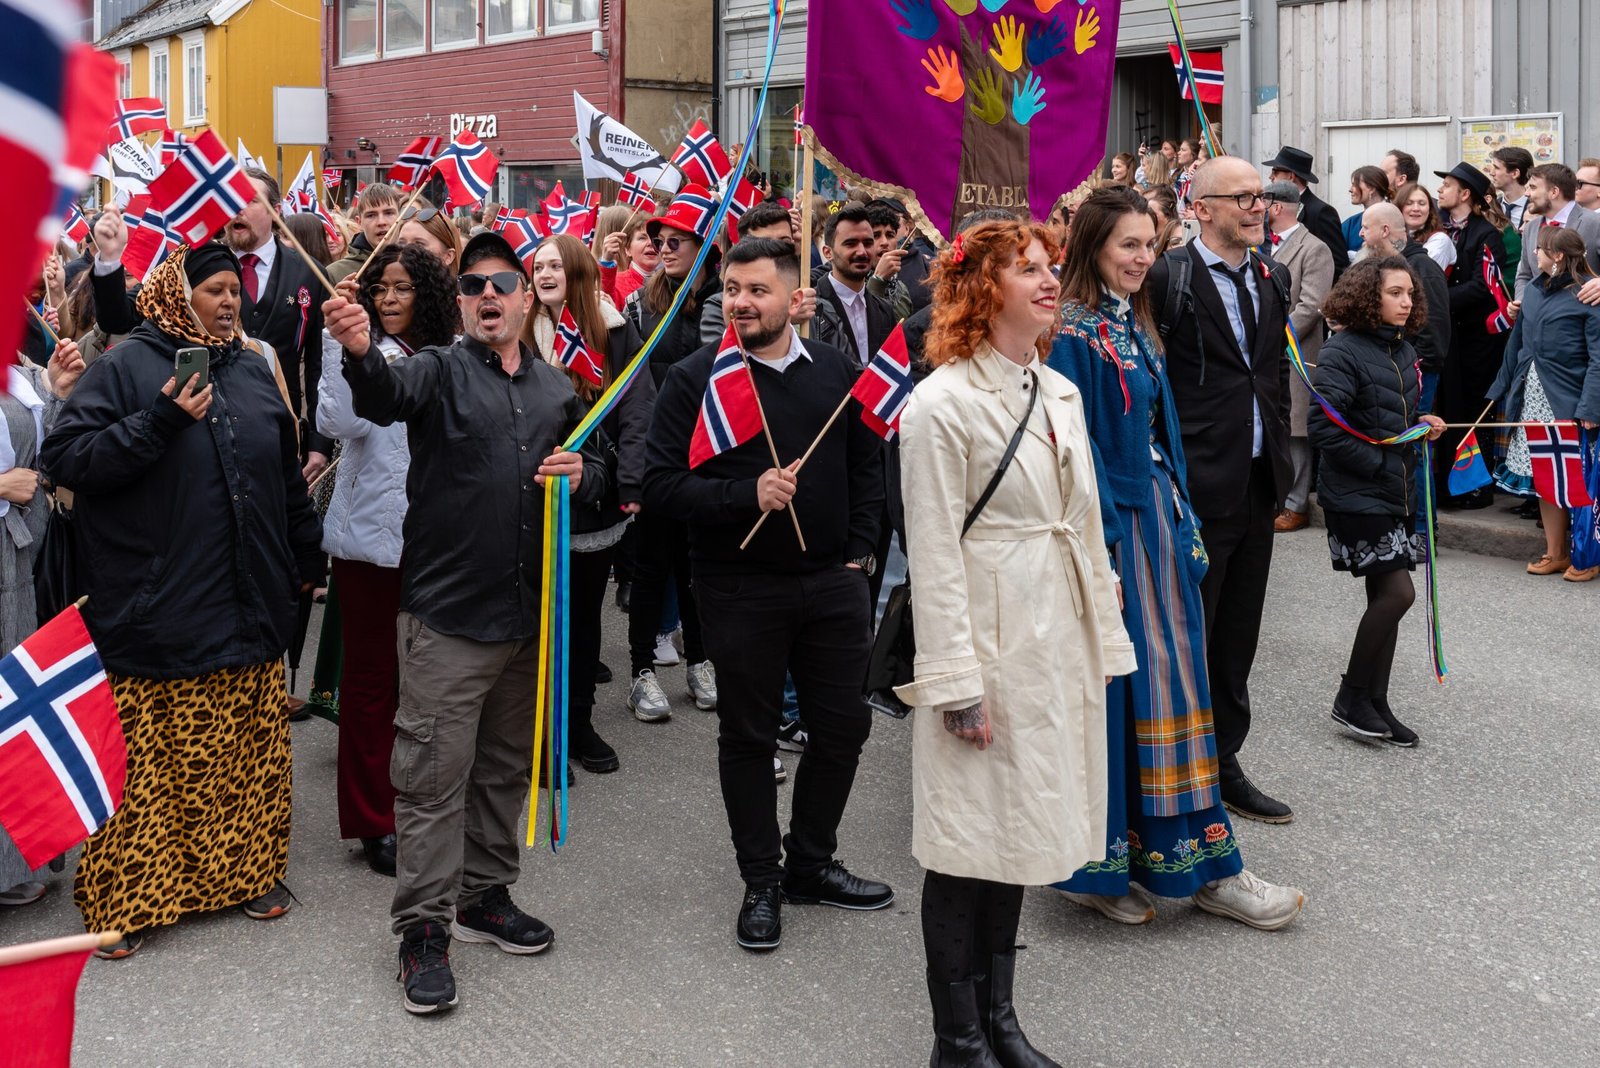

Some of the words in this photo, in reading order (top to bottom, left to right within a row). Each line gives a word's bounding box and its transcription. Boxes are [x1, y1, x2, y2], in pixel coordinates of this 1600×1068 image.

[450, 113, 497, 144] pizza
[605, 133, 655, 152] REINEN
[960, 182, 1029, 208] ETABL
